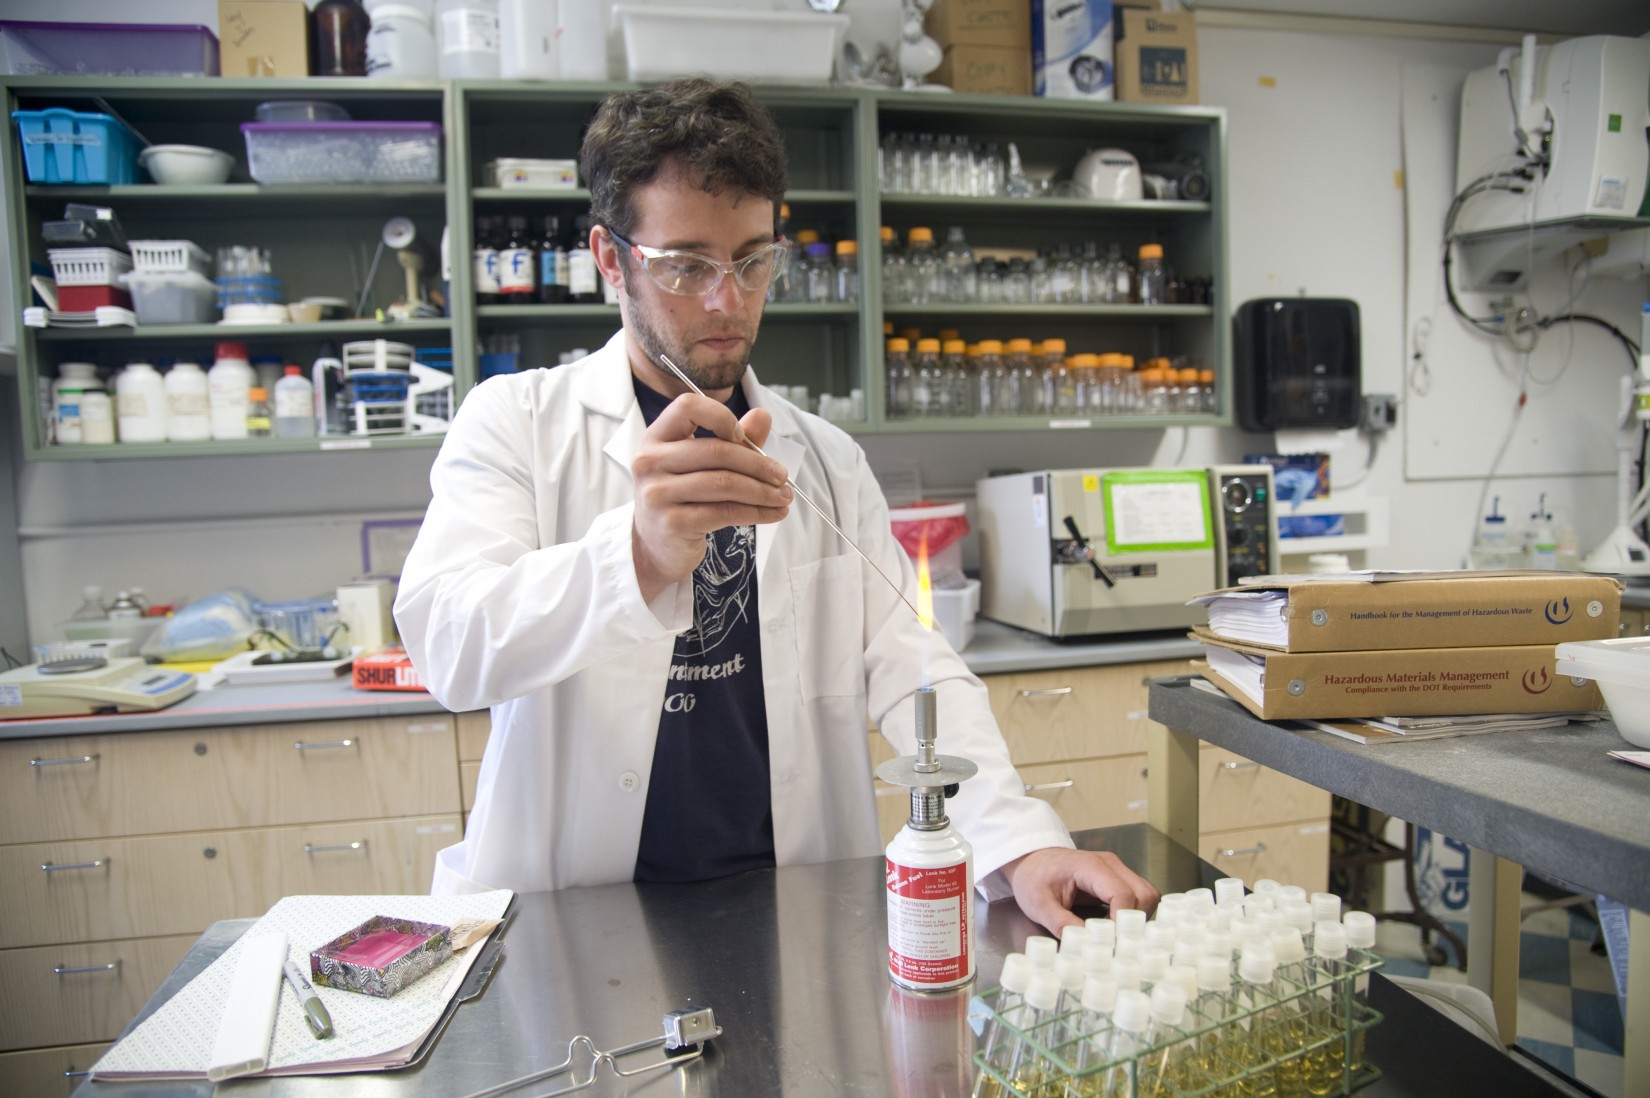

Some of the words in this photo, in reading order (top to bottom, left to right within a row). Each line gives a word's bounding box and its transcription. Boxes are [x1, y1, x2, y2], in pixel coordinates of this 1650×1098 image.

[1350, 611, 1387, 620] Handbook
[1389, 611, 1400, 619] for
[1402, 610, 1413, 618] the
[1415, 609, 1461, 620] Management
[1463, 608, 1471, 616] of
[1472, 608, 1510, 616] Hazardous
[1511, 607, 1533, 615] Waste
[1324, 673, 1383, 684] Hazardous
[1386, 672, 1437, 683] Materials
[1439, 670, 1510, 683] Management
[1345, 685, 1389, 695] Compliance
[1390, 684, 1407, 693] with
[1409, 684, 1421, 692] the
[1422, 684, 1440, 692] DOT
[1442, 682, 1492, 693] Requirements
[908, 871, 923, 883] Fuel
[900, 899, 930, 908] WARNING
[904, 962, 919, 972] Lenk
[920, 963, 959, 973] Corporation
